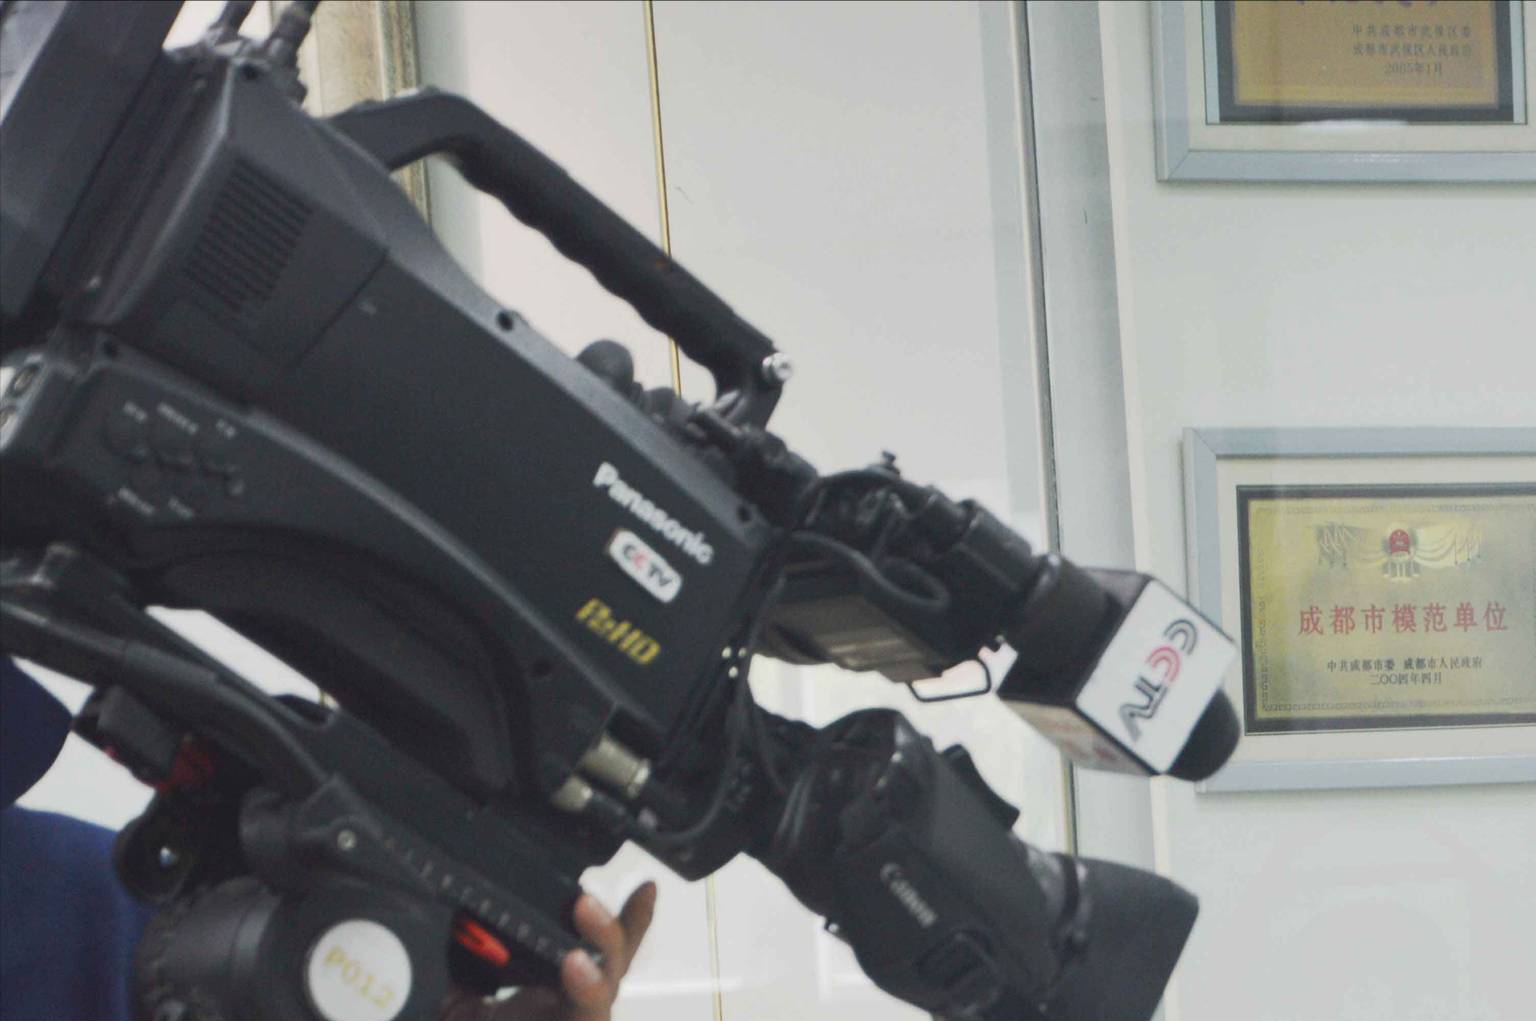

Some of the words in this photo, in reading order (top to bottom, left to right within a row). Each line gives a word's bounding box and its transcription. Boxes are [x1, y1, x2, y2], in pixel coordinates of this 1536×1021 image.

[593, 461, 714, 565] Panasonic
[1297, 601, 1509, 637] 成都市模范单位
[1118, 617, 1199, 742] CCTV
[1327, 657, 1396, 673] 中共成都市委
[1403, 655, 1483, 671] 成都市人民政府
